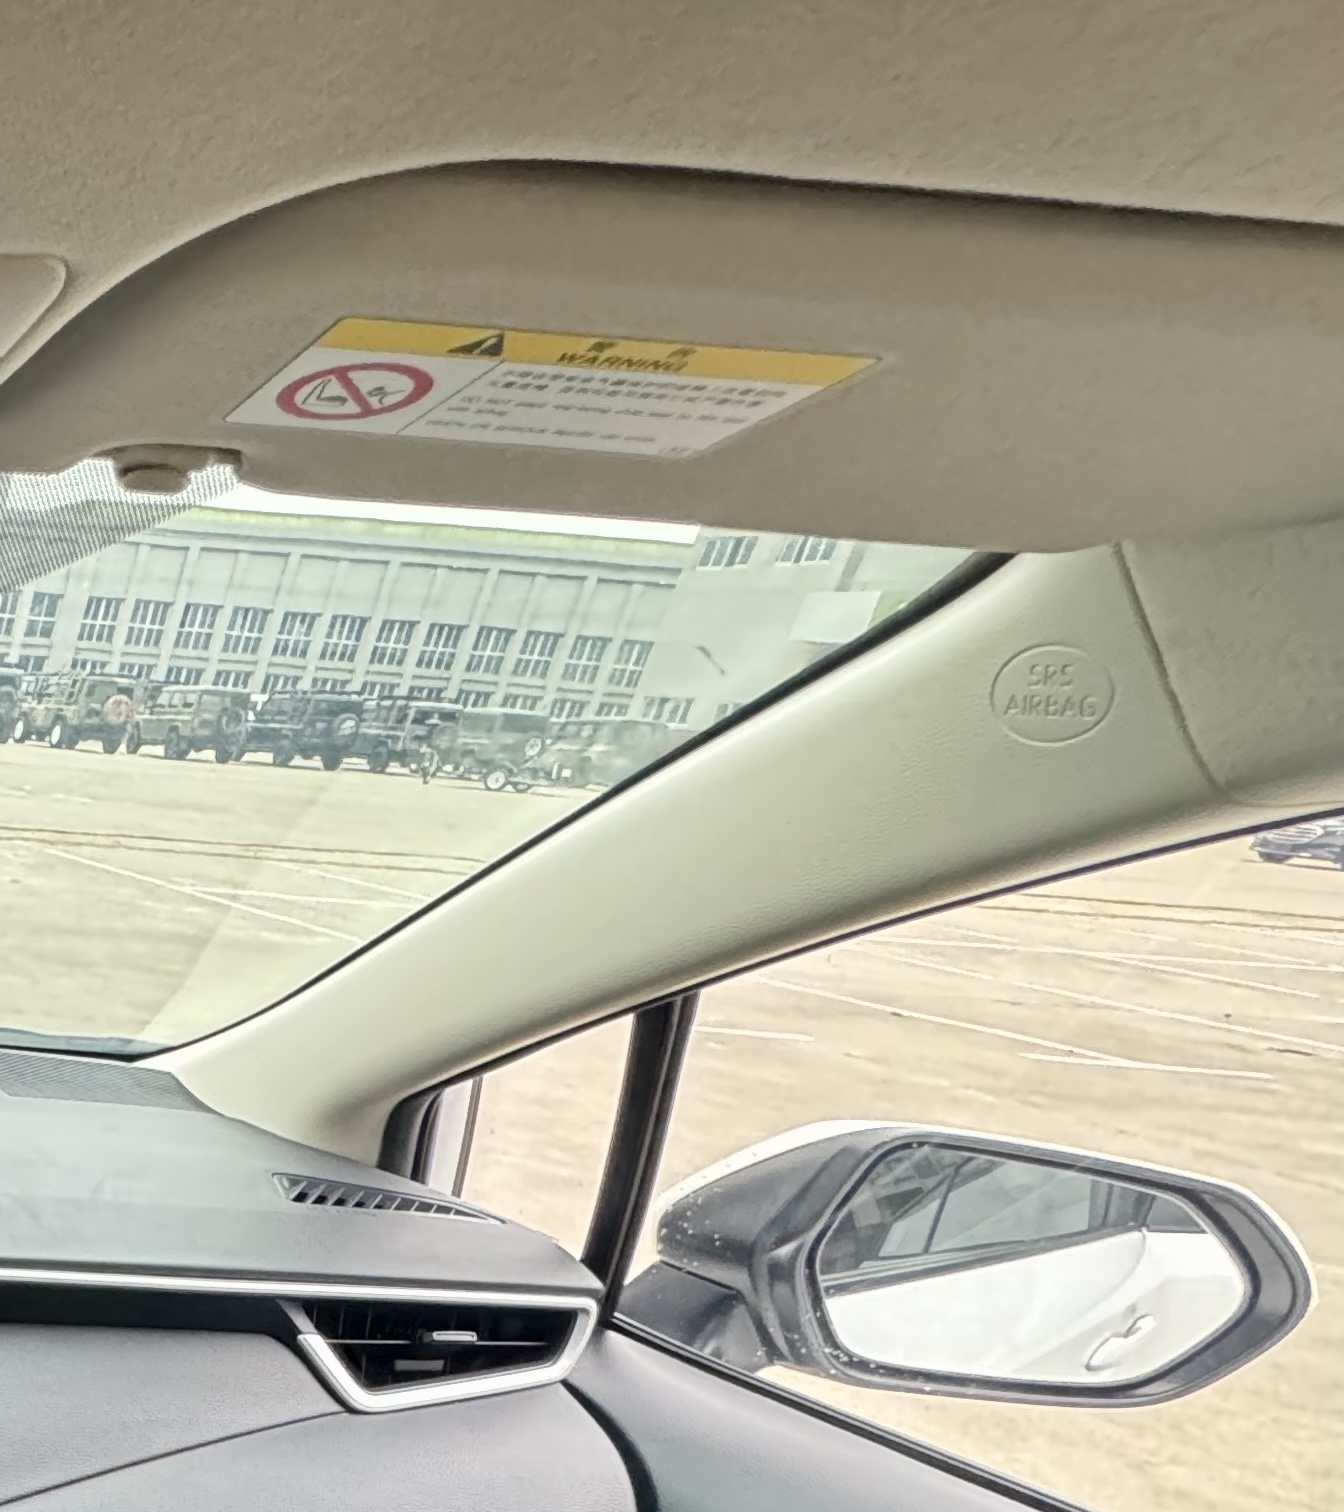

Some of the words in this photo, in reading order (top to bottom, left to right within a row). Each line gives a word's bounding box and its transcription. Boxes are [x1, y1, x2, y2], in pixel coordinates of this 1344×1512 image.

[556, 353, 689, 373] WARNING
[1026, 663, 1074, 690] SRS
[1002, 694, 1097, 721] AIRBAG
